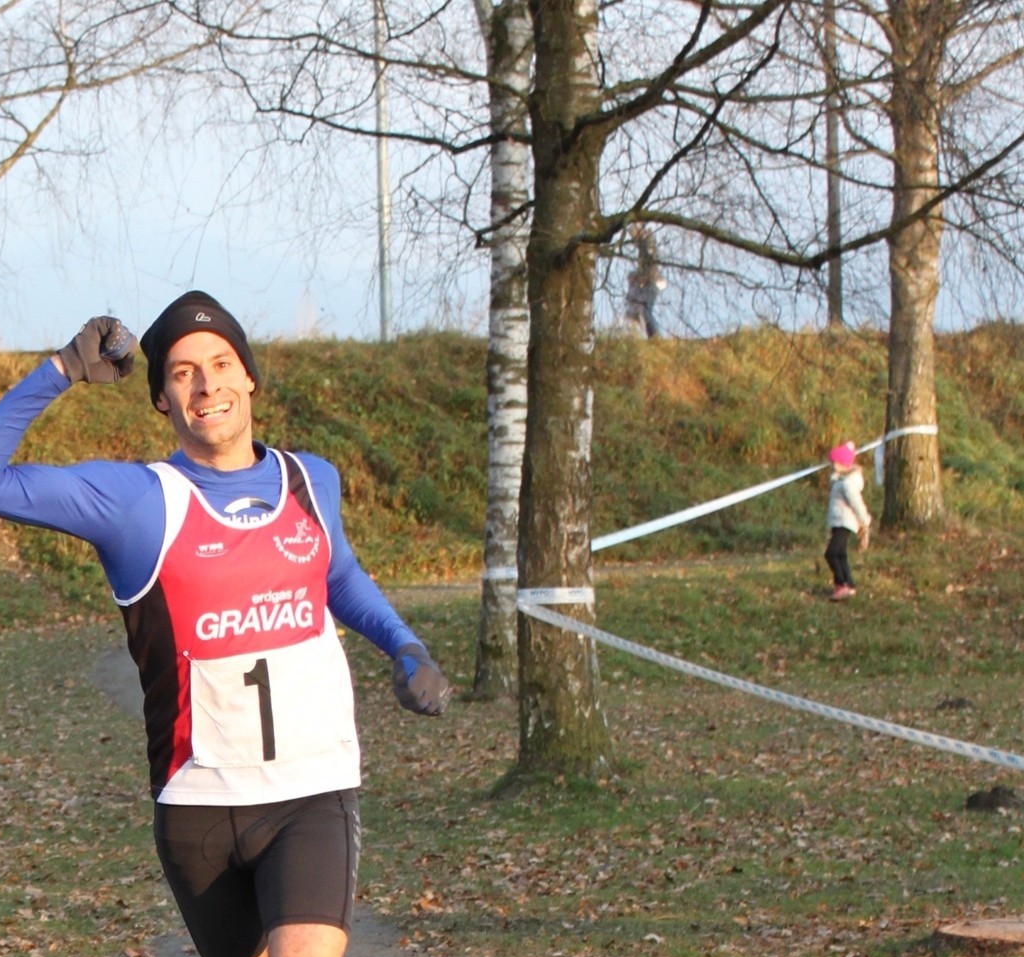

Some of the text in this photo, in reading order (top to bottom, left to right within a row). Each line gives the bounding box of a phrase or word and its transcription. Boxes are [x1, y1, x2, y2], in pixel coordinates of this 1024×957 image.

[251, 590, 293, 604] erdgas
[195, 600, 314, 641] GRAVAG
[243, 658, 276, 762] 1
